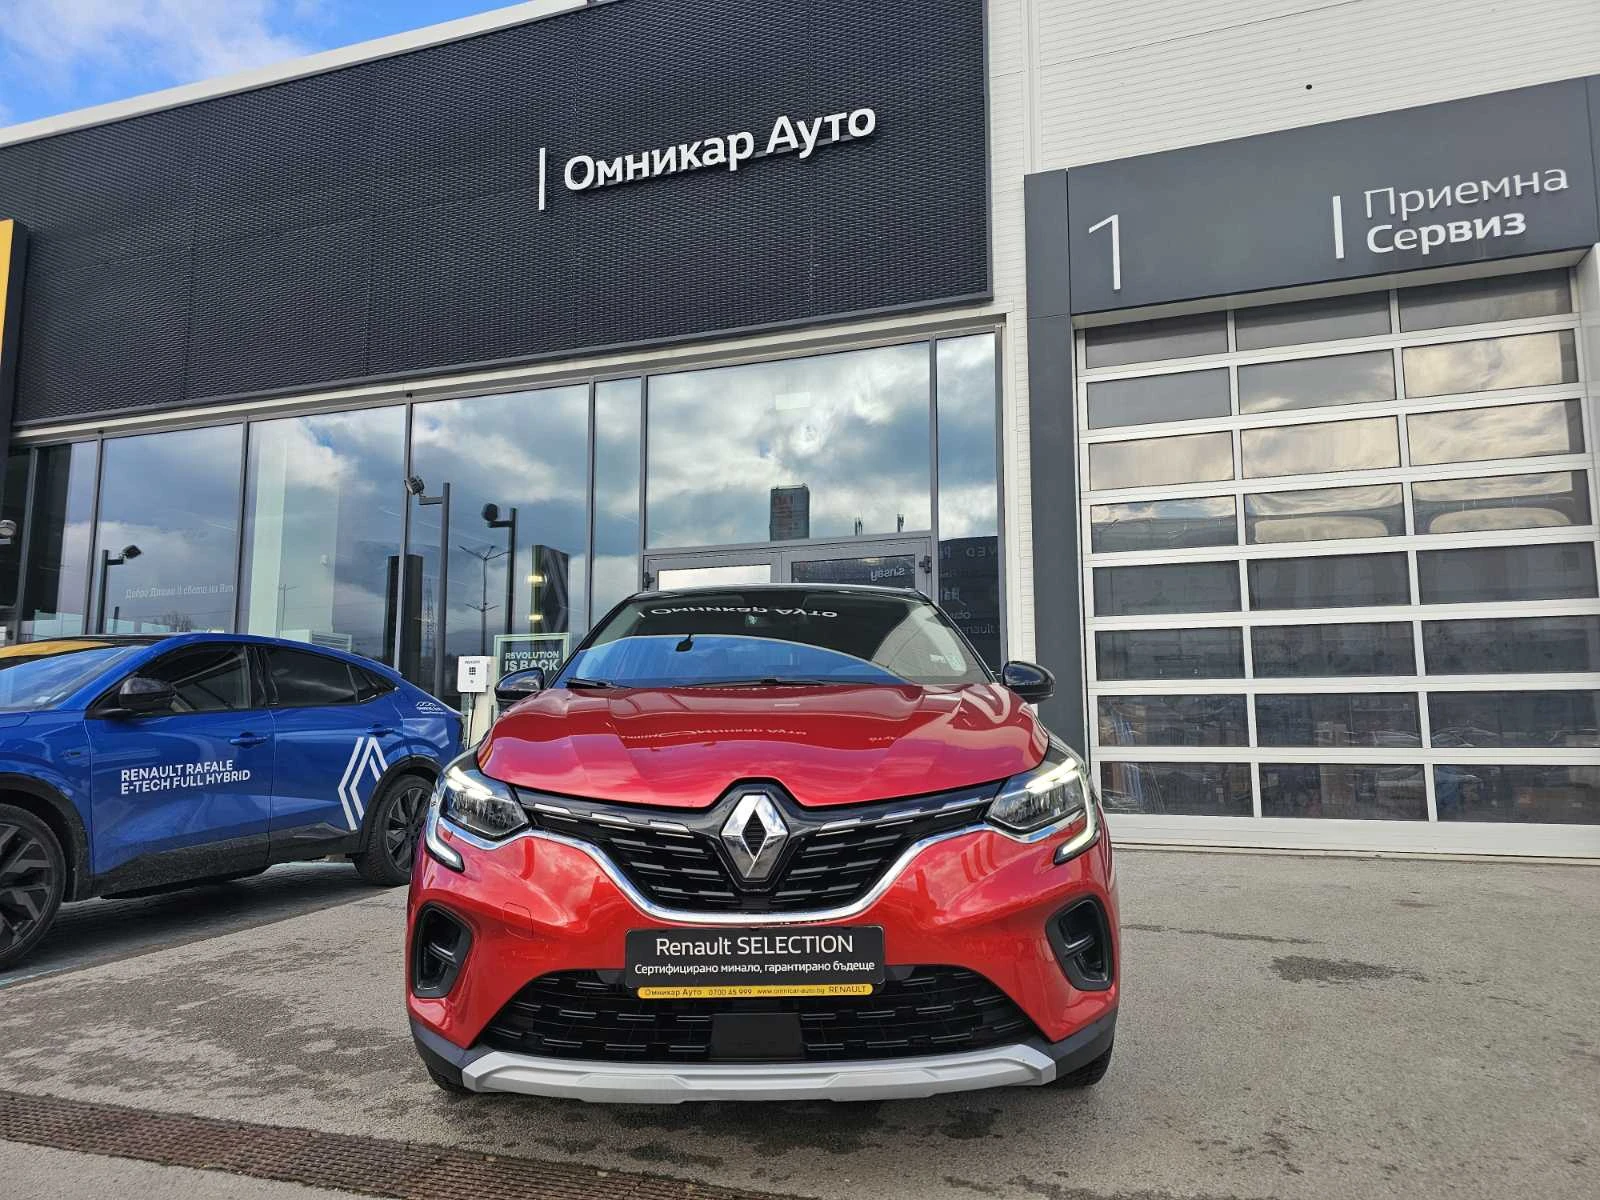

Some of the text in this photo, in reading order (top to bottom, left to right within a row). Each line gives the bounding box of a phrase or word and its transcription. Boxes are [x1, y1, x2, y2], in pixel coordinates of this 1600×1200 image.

[563, 107, 877, 192] Омникар Ауто
[1364, 168, 1569, 221] Приемна
[1366, 212, 1527, 255] Сервиз
[1088, 213, 1121, 290] 1
[121, 760, 233, 782] RENAULT RAFALE
[121, 769, 251, 795] E-TECH FULL HYBRID
[656, 935, 854, 956] Renault SELECTION
[634, 960, 876, 976] Сертифицирано минало, гарантирано бъдеще
[828, 984, 867, 994] RENAULT
